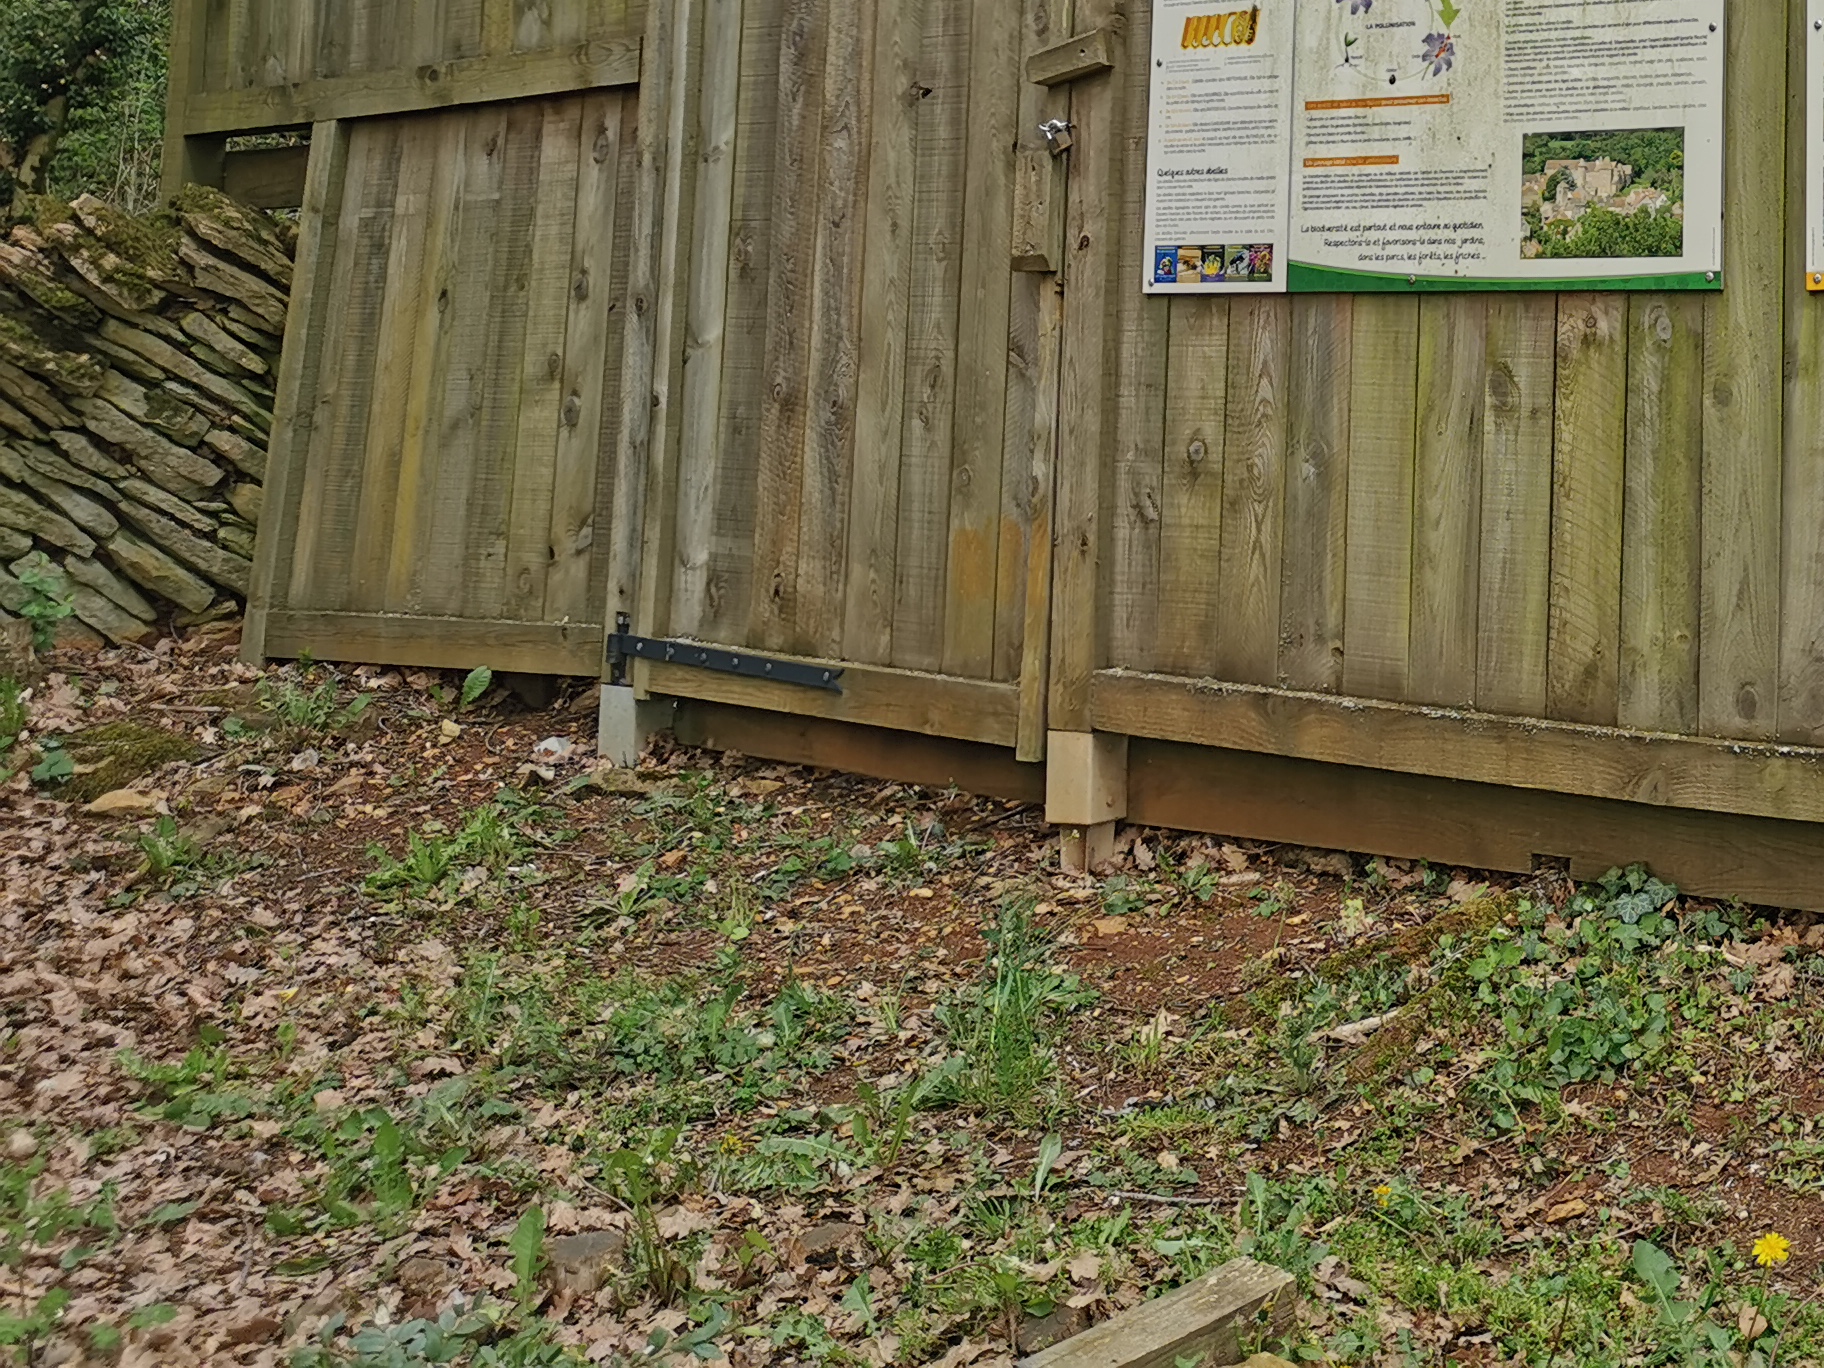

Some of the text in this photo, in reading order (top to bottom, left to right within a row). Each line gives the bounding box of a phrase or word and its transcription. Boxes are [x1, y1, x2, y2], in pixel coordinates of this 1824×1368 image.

[1301, 224, 1309, 232] La
[1310, 223, 1348, 232] biodiversité
[1363, 223, 1387, 233] partout
[1388, 222, 1397, 230] et
[1415, 222, 1441, 231] entoure
[1324, 238, 1372, 248] Respectons-la
[1372, 237, 1381, 246] et
[1382, 237, 1425, 250] favorisons-la
[1426, 237, 1442, 246] dans
[1358, 253, 1373, 261] dans
[1375, 252, 1384, 260] les
[1407, 252, 1416, 260] les
[1443, 252, 1453, 260] les
